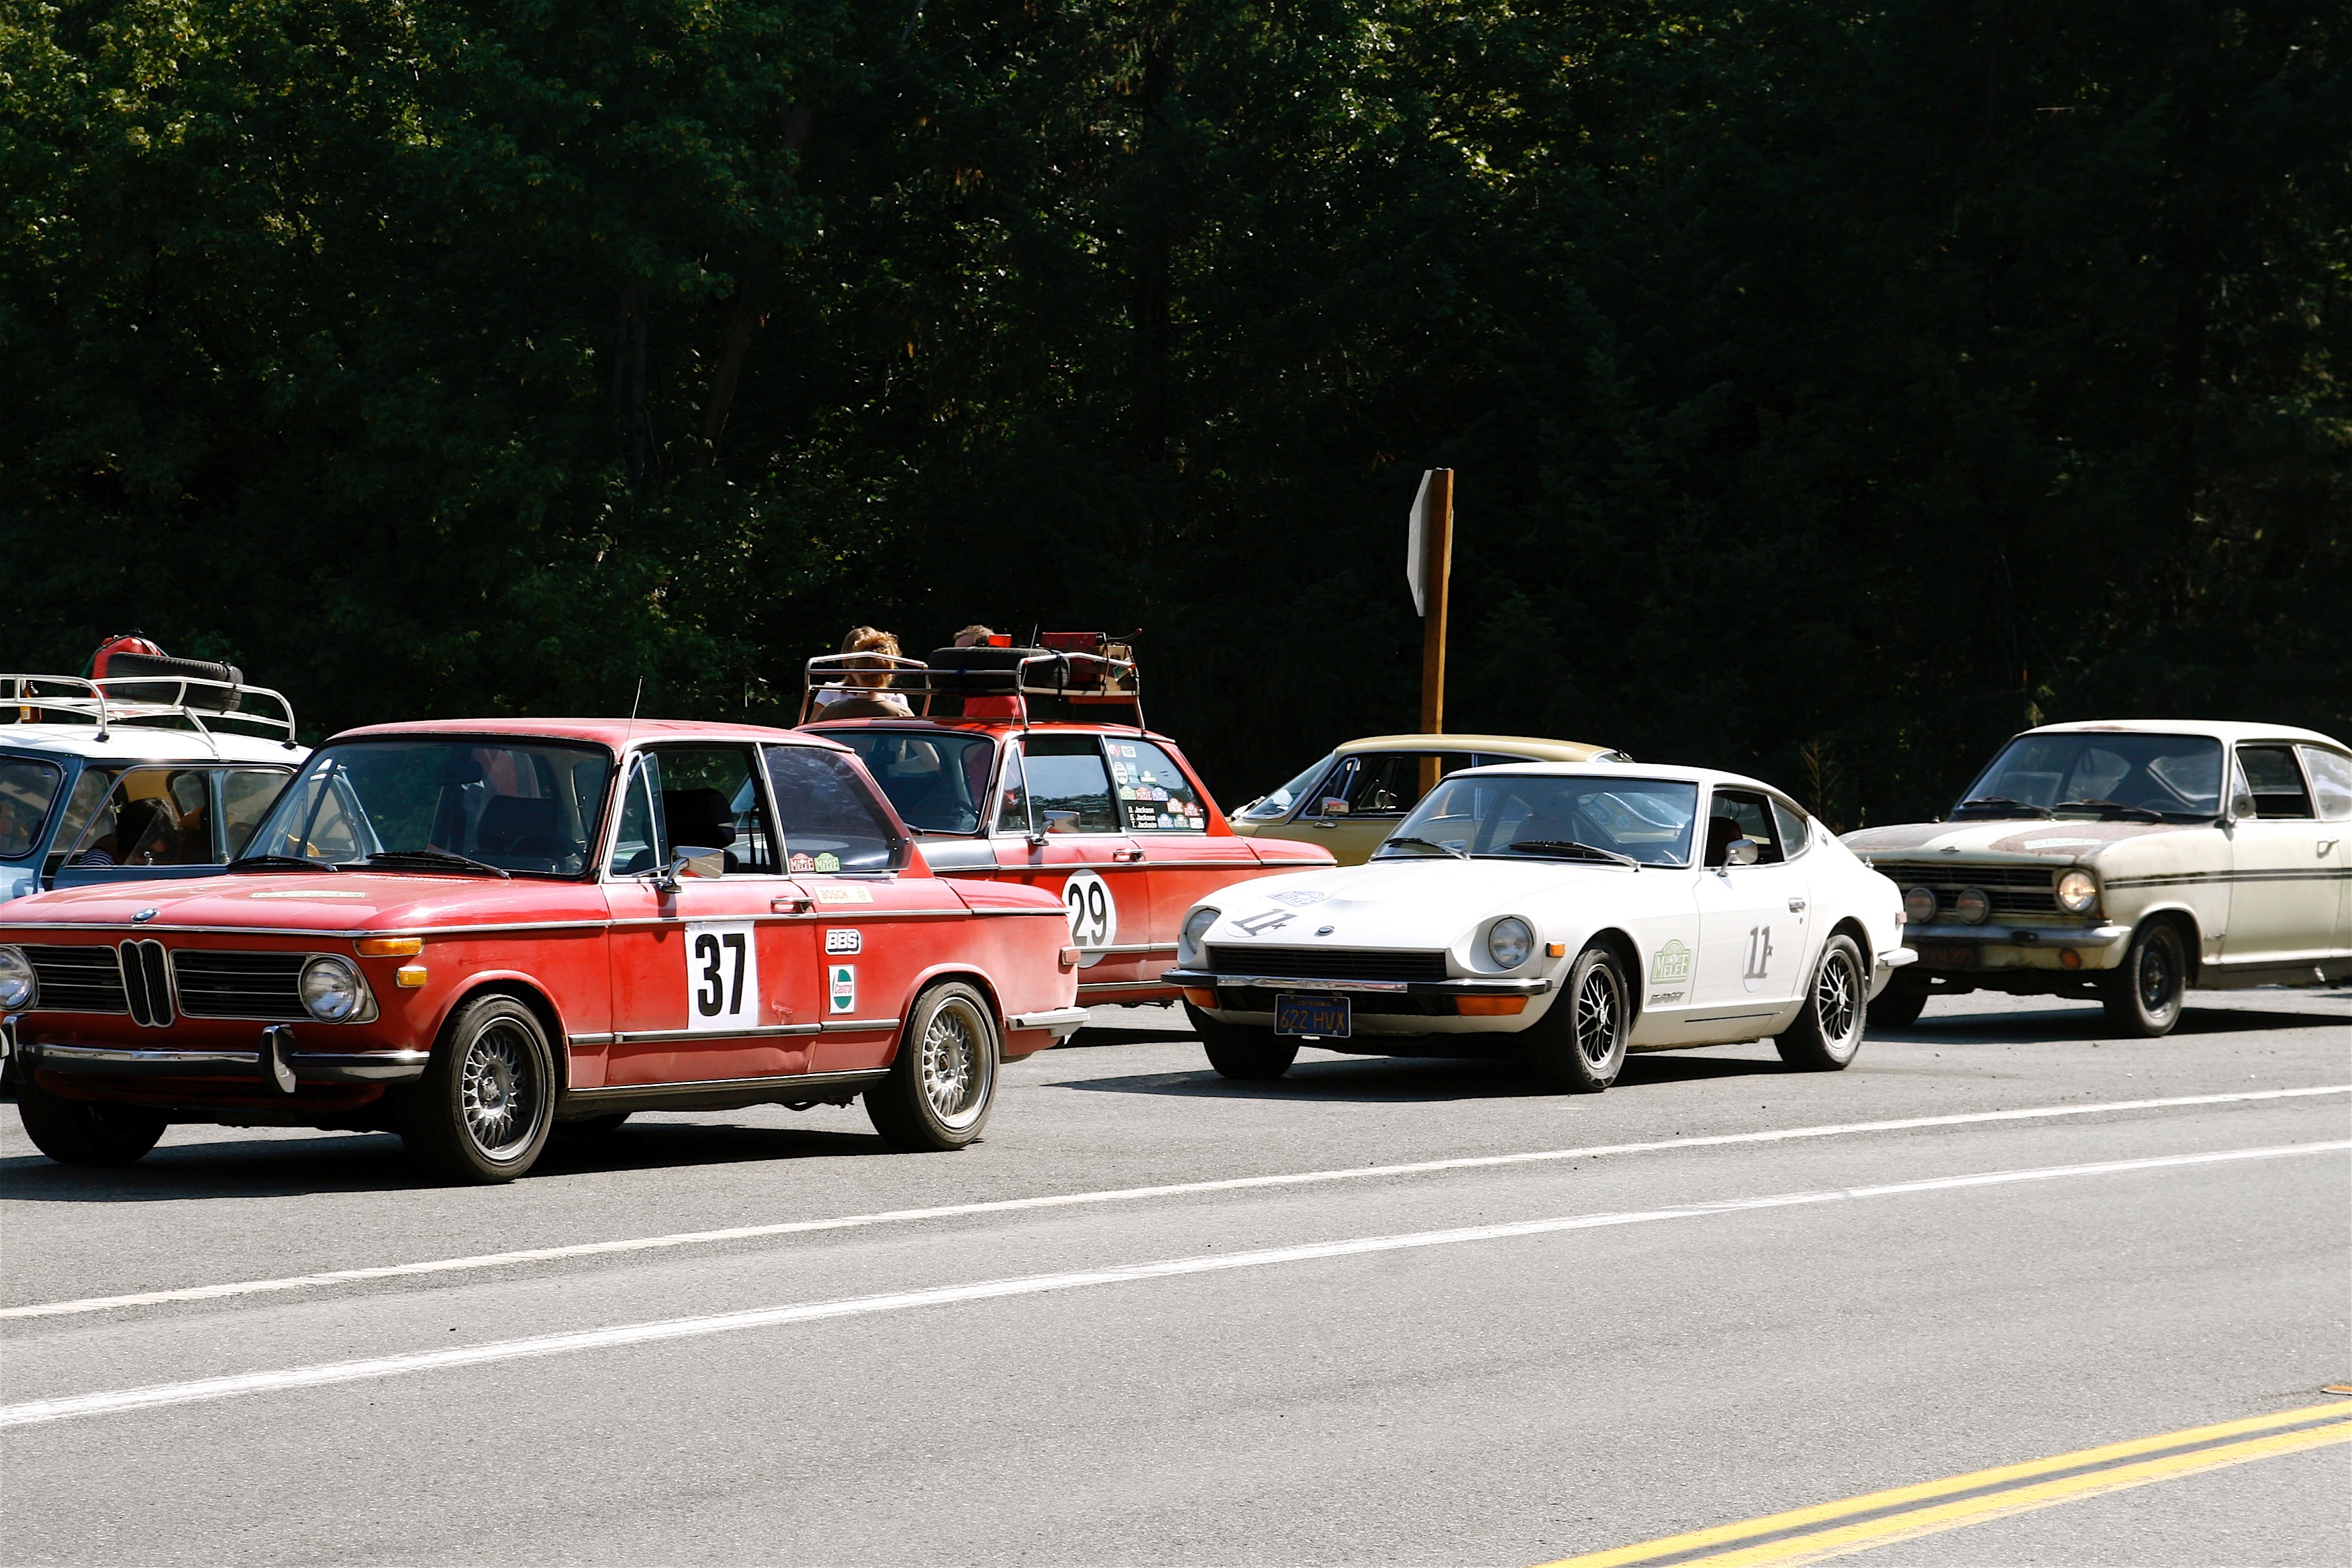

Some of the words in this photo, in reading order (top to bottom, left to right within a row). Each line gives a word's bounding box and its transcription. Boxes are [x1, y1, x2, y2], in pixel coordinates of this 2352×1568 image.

[1136, 814, 1156, 822] Jackson
[820, 889, 849, 900] BOSCH
[1069, 881, 1107, 946] 29
[826, 931, 860, 952] BBS
[695, 933, 746, 1017] 37
[1653, 954, 1689, 979] MELEE
[834, 983, 853, 995] Castrol
[1280, 1009, 1309, 1030] 622
[1314, 1011, 1345, 1030] HVX
